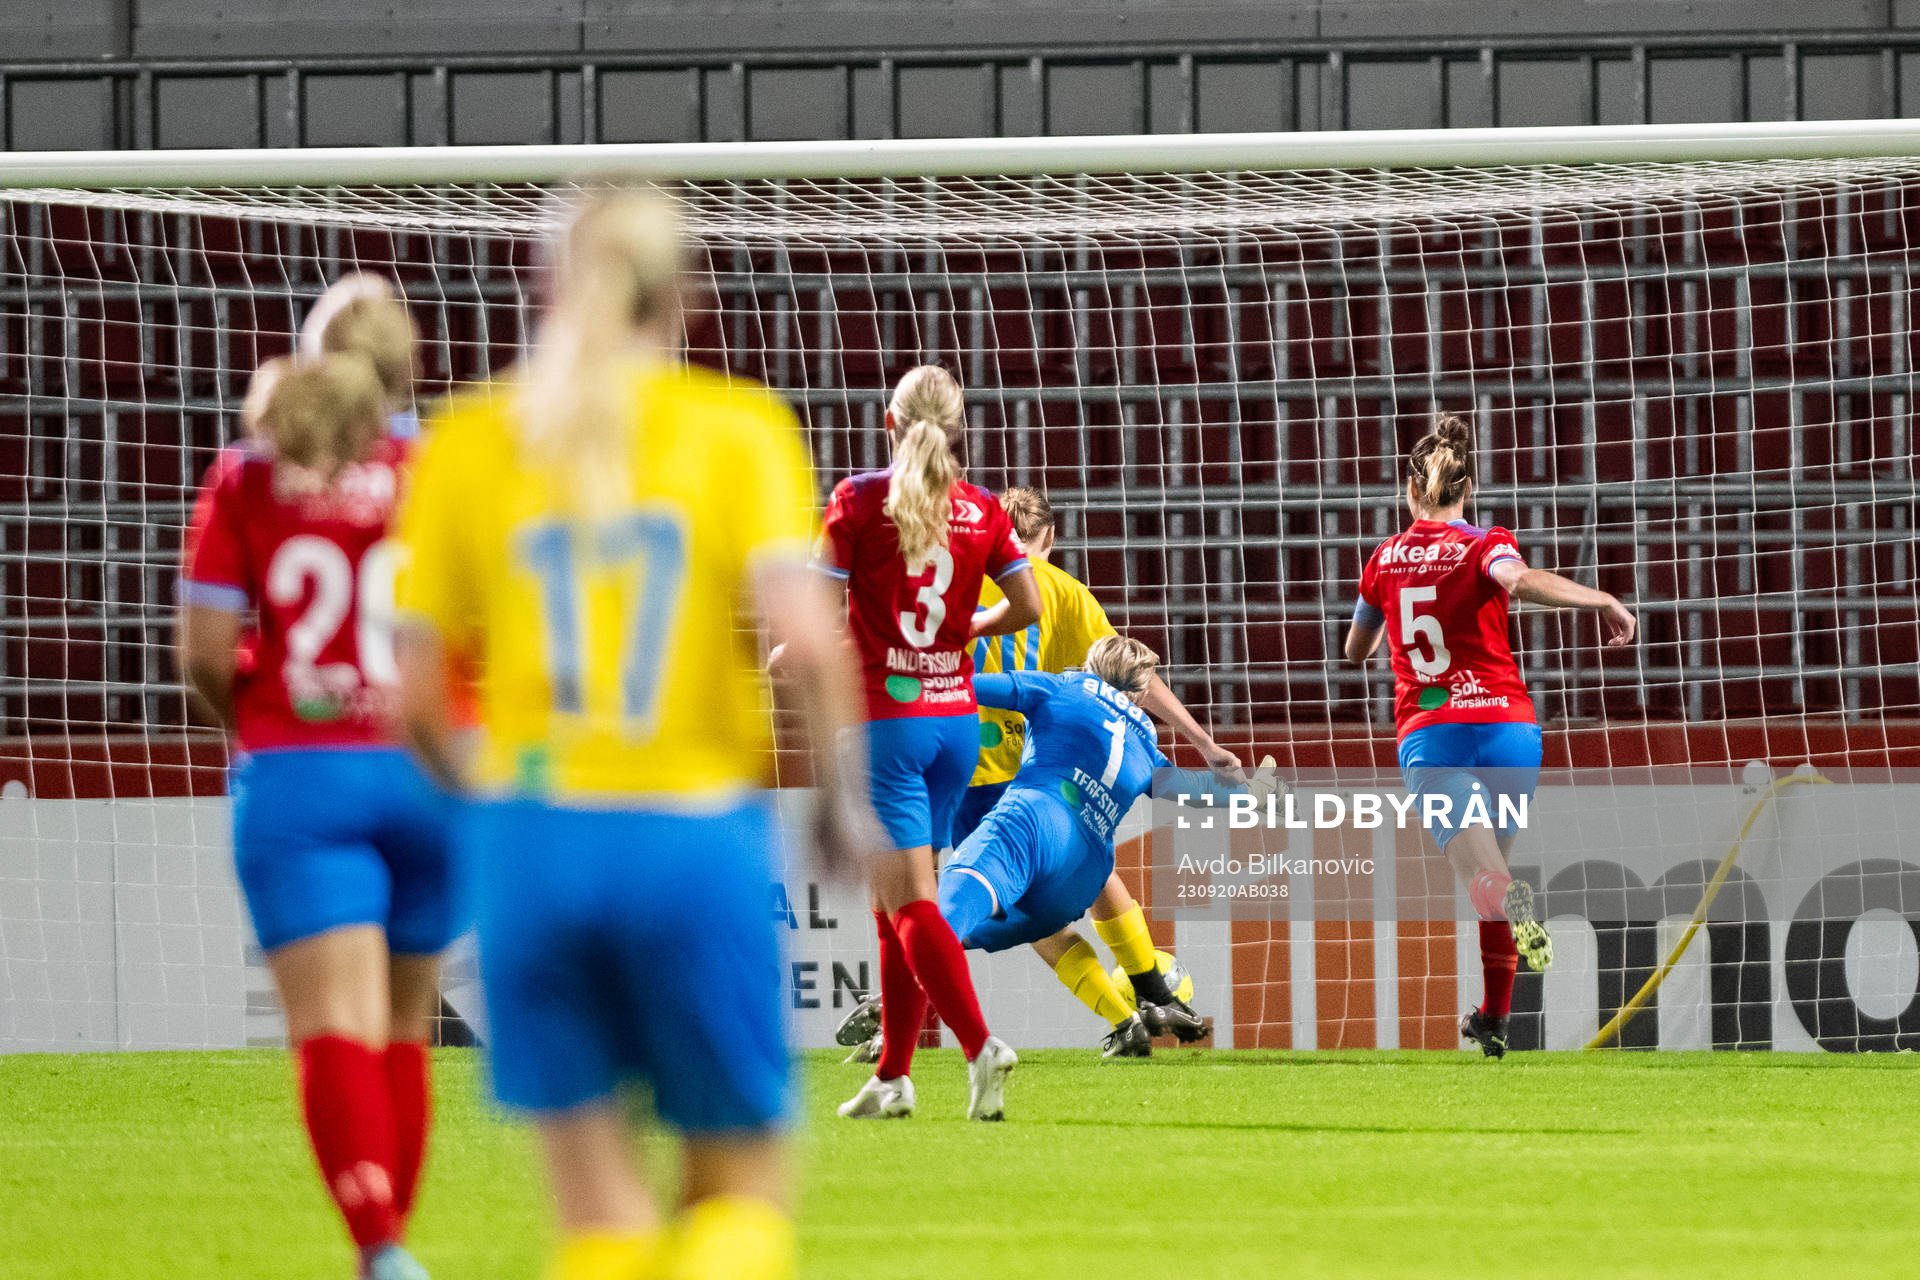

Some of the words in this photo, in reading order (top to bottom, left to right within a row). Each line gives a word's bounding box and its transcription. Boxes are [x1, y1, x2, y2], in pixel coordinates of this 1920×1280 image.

[1380, 541, 1440, 565] akea
[513, 507, 688, 728] 17
[899, 543, 954, 647] 3
[1400, 585, 1451, 676] 5
[1083, 678, 1143, 724] akea
[1451, 694, 1510, 709] Försäkring
[1102, 717, 1126, 790] 1
